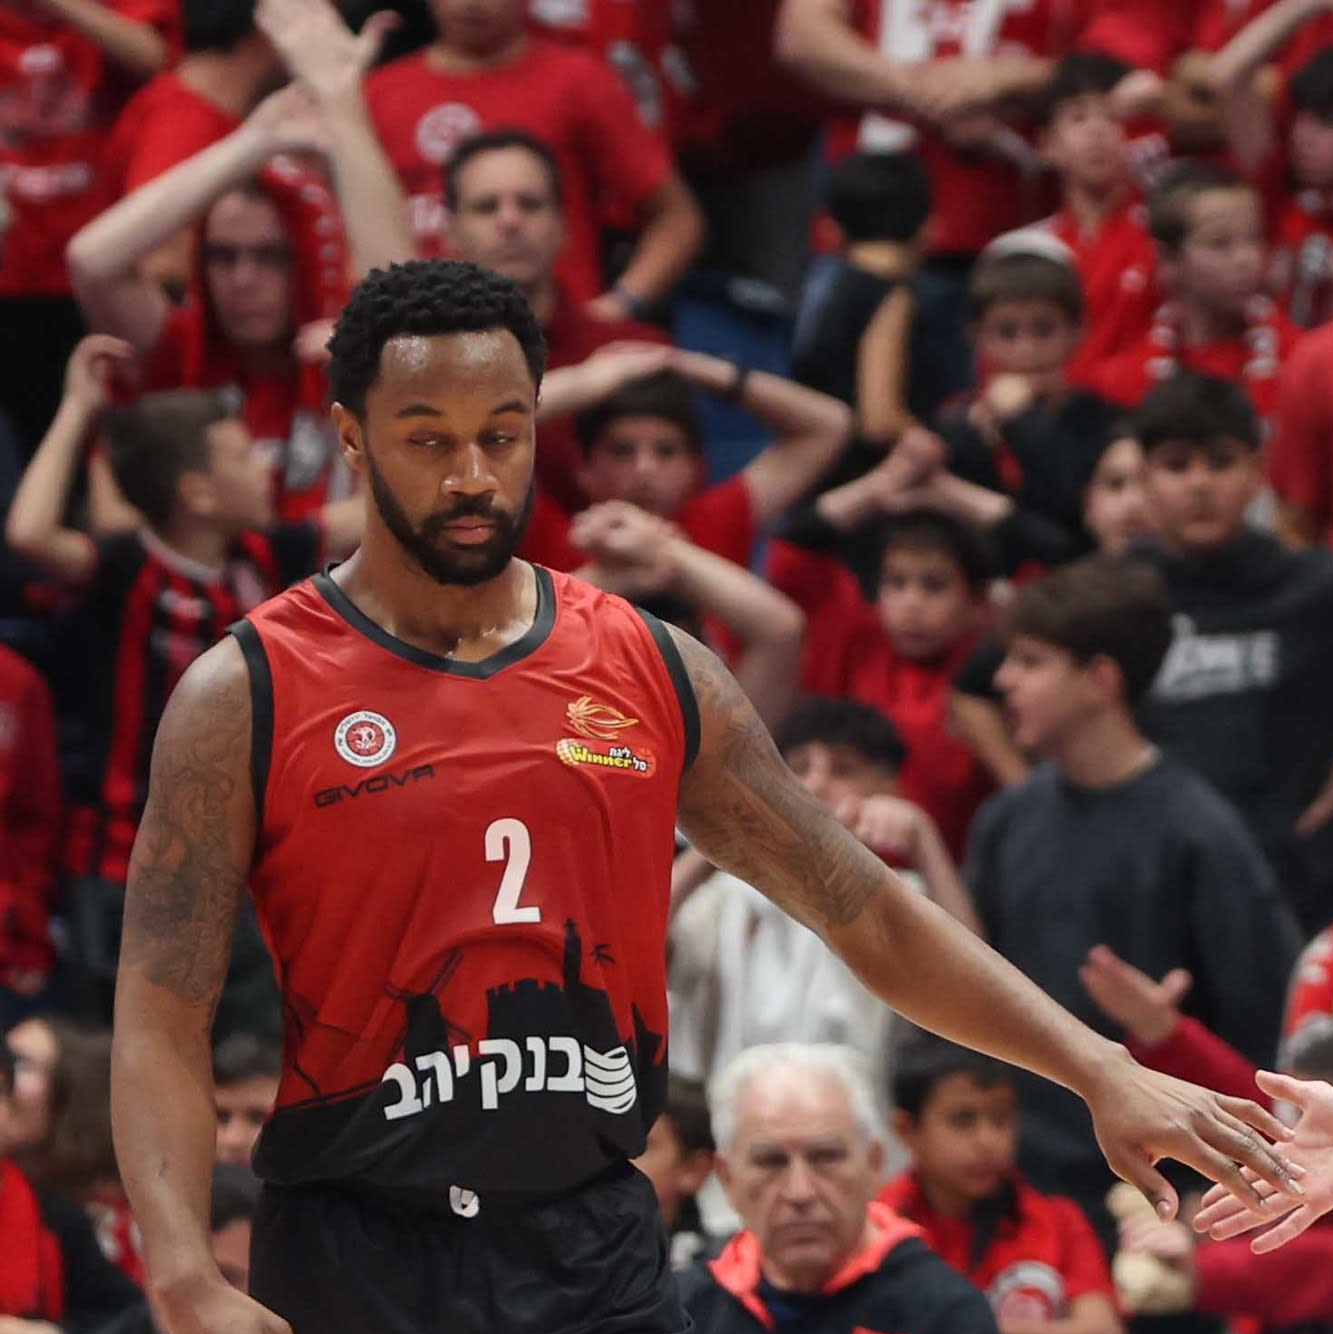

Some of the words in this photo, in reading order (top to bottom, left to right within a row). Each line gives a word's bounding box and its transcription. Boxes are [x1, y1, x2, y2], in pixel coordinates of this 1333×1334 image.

[314, 764, 435, 808] GIVOVA
[485, 818, 541, 925] 2
[381, 1044, 471, 1120] יהב
[479, 1036, 585, 1110] בנק
